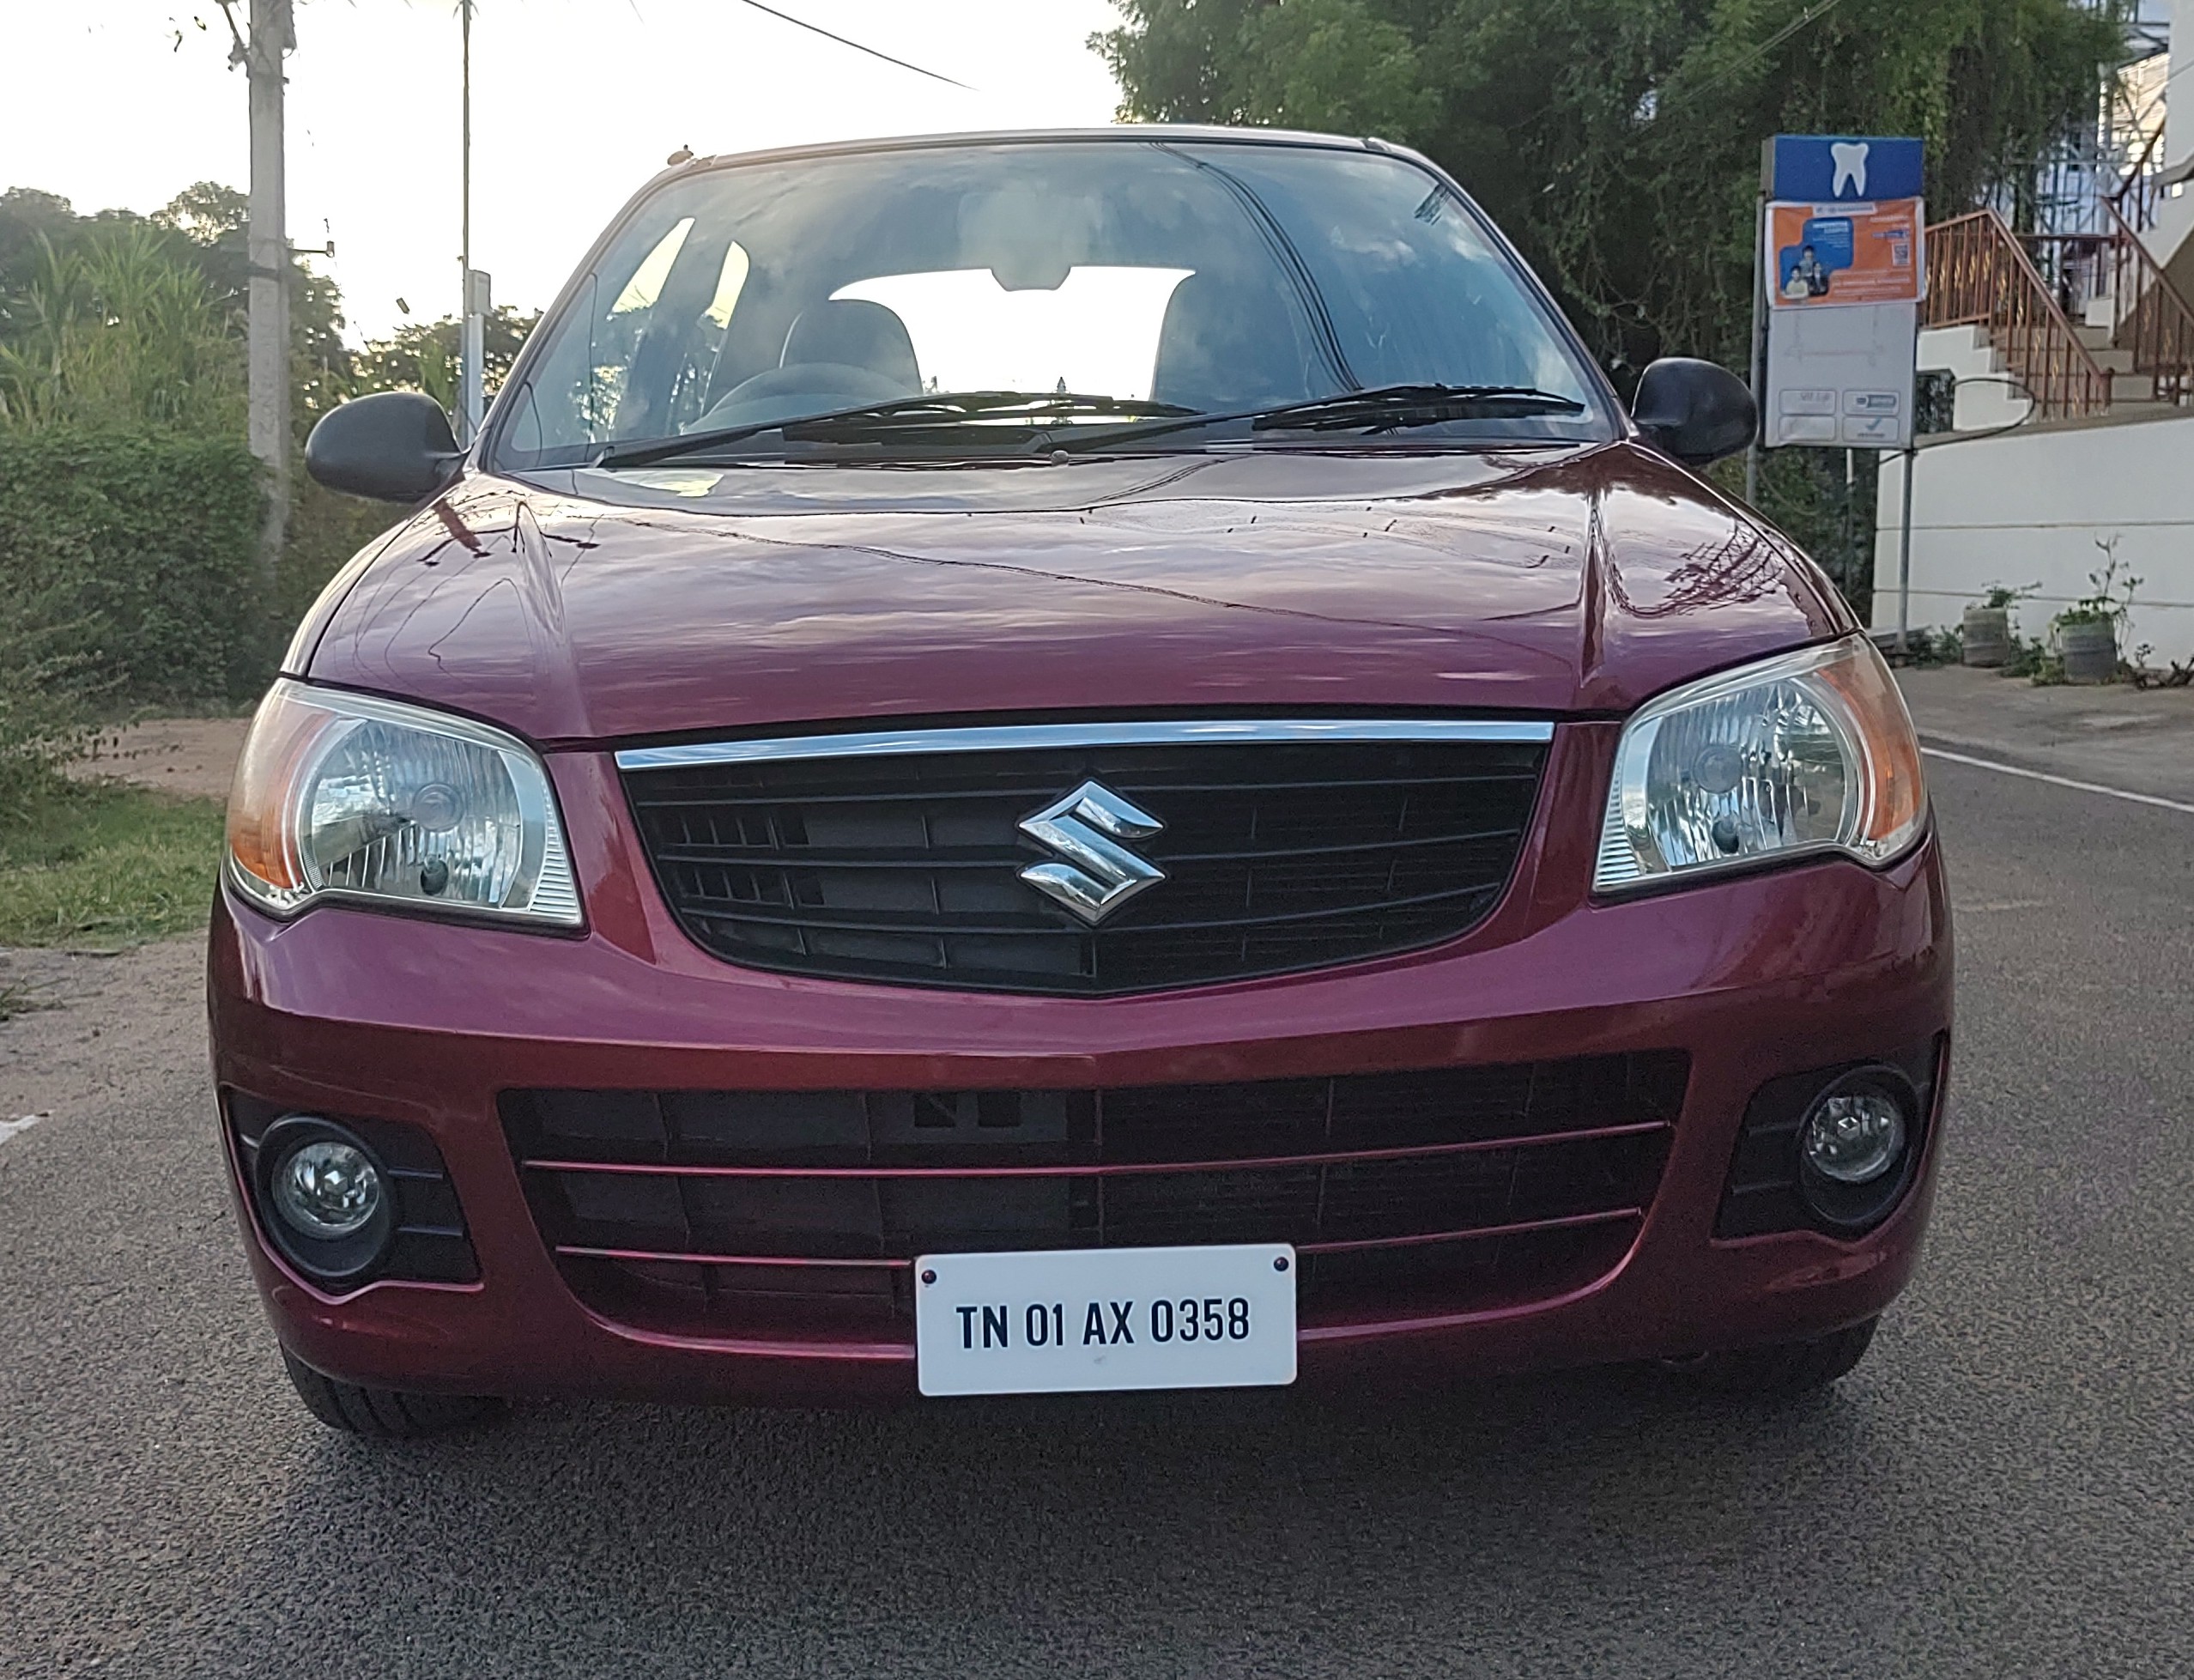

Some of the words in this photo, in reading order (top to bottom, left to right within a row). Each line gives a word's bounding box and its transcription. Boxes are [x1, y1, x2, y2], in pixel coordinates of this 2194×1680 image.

[956, 1305, 1009, 1349] TN
[1026, 1303, 1064, 1346] 01
[1082, 1301, 1135, 1345] AX
[1151, 1297, 1250, 1343] 0358
